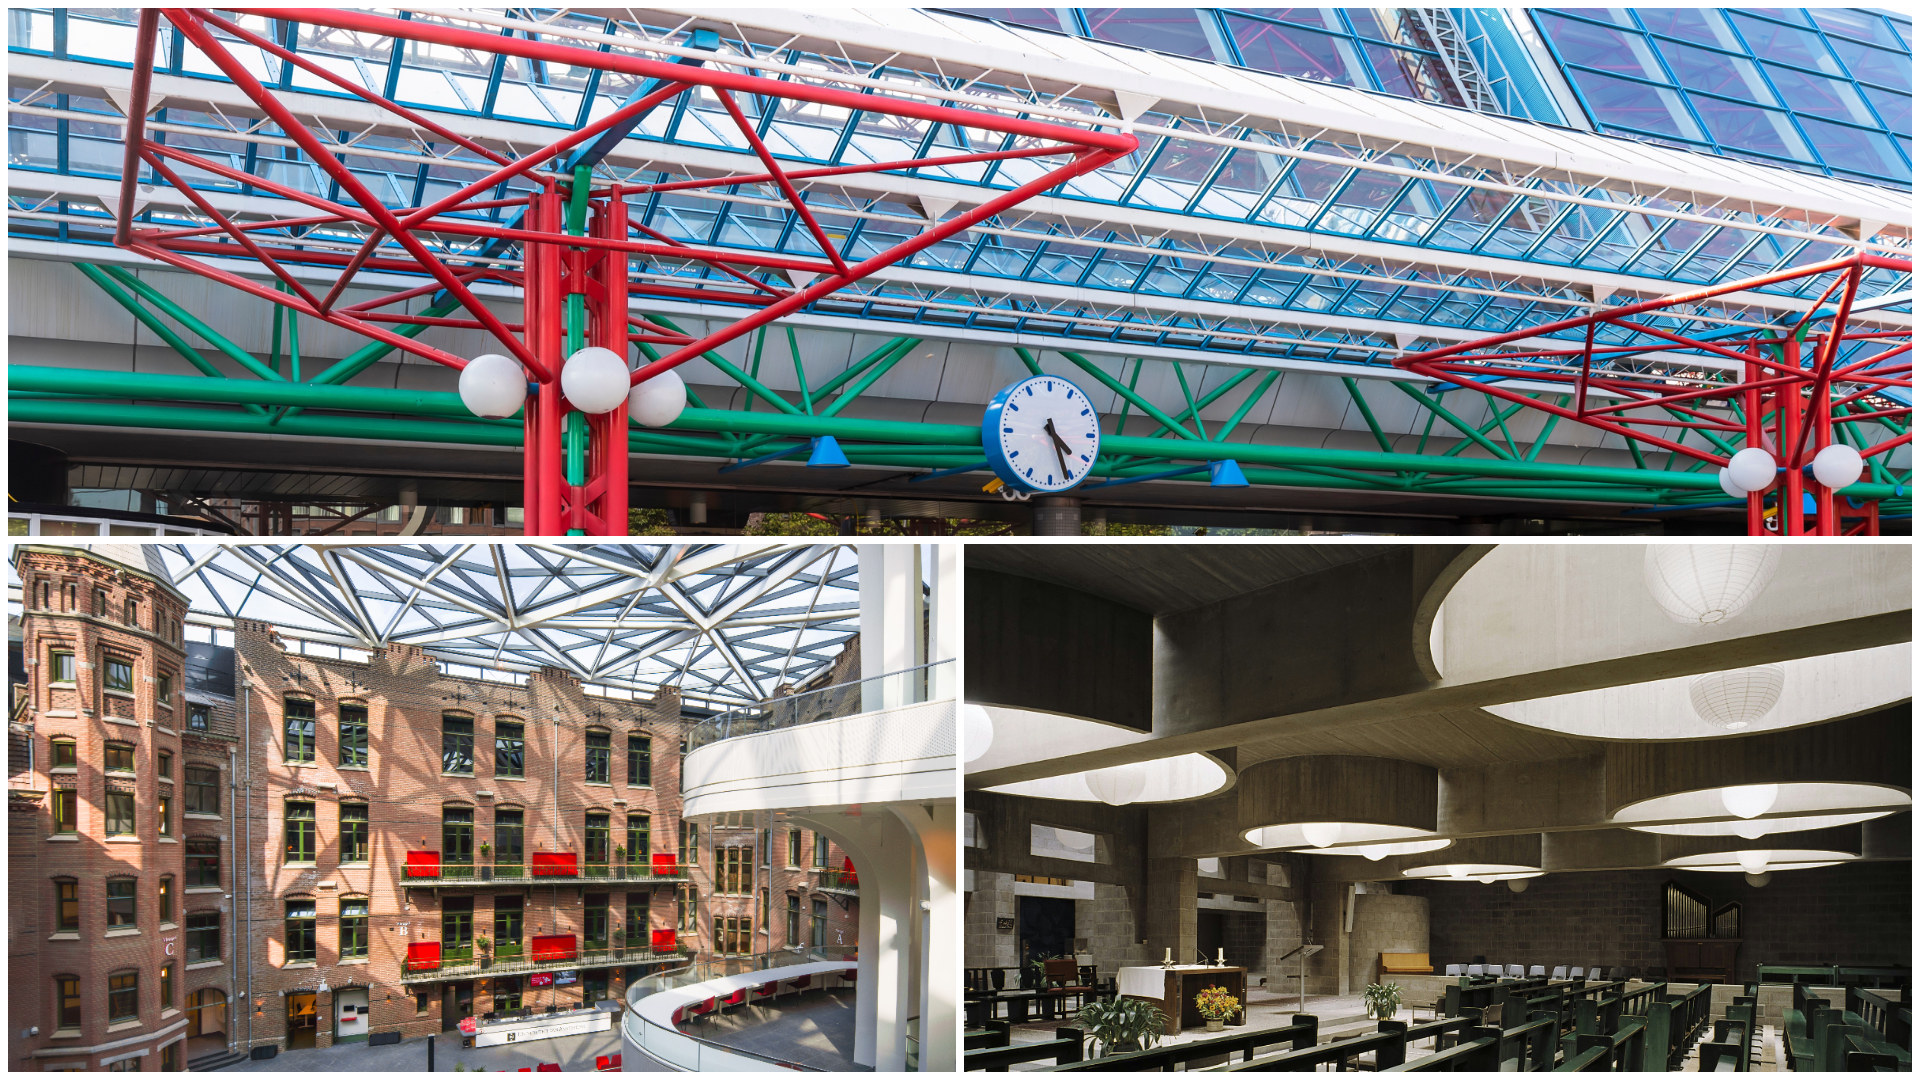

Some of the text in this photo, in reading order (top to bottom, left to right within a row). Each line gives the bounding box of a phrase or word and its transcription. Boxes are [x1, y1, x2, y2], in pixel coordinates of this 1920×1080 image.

[399, 926, 409, 936] B
[836, 933, 844, 945] A
[165, 942, 174, 956] C
